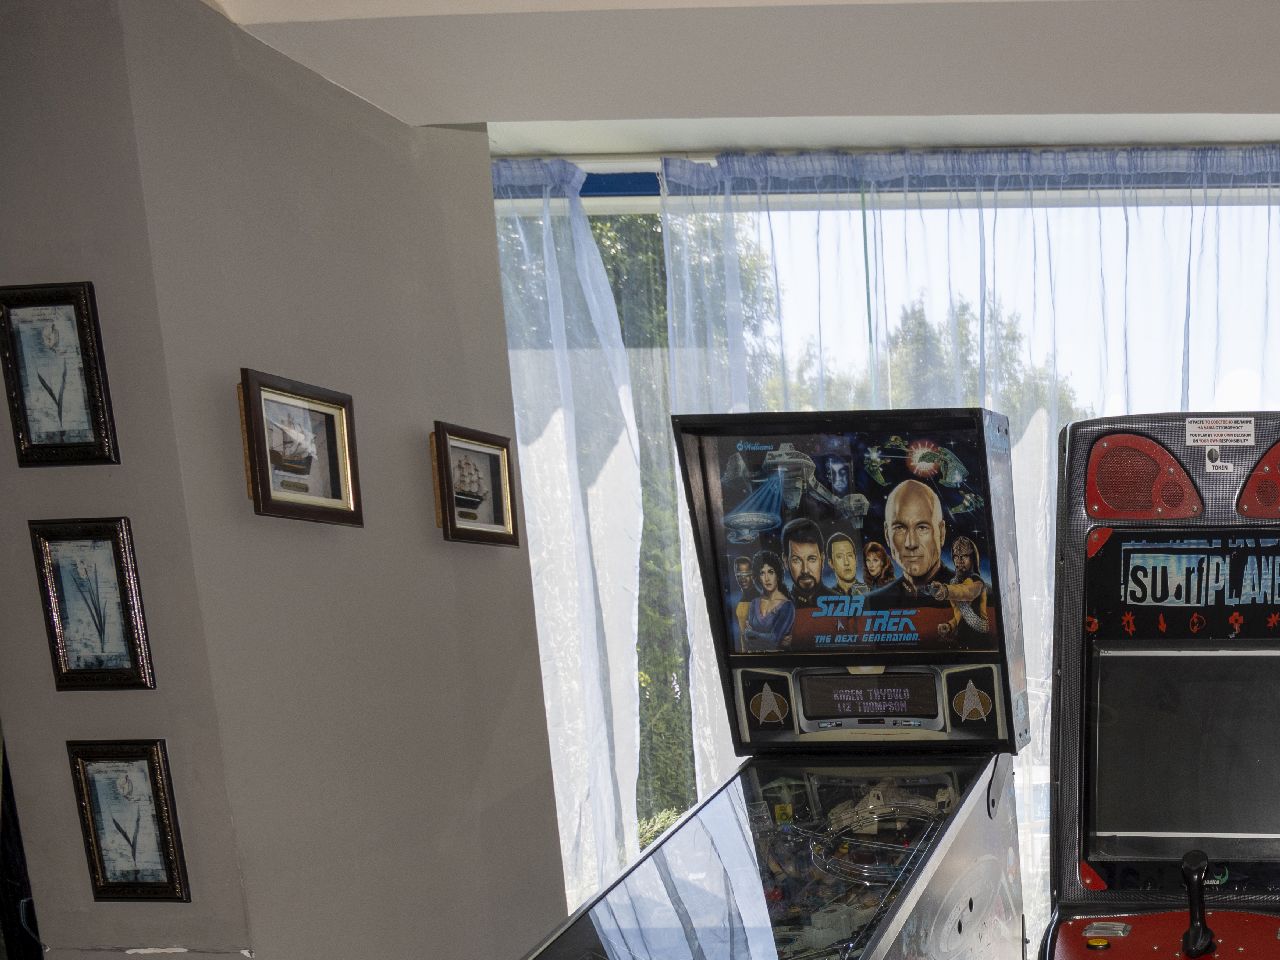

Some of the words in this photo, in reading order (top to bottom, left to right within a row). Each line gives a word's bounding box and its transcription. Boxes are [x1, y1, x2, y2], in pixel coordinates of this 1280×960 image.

[812, 595, 865, 617] STAR
[863, 609, 918, 632] TREK
[815, 635, 831, 643] THE
[835, 634, 859, 642] NEXT
[833, 689, 863, 700] KAREN
